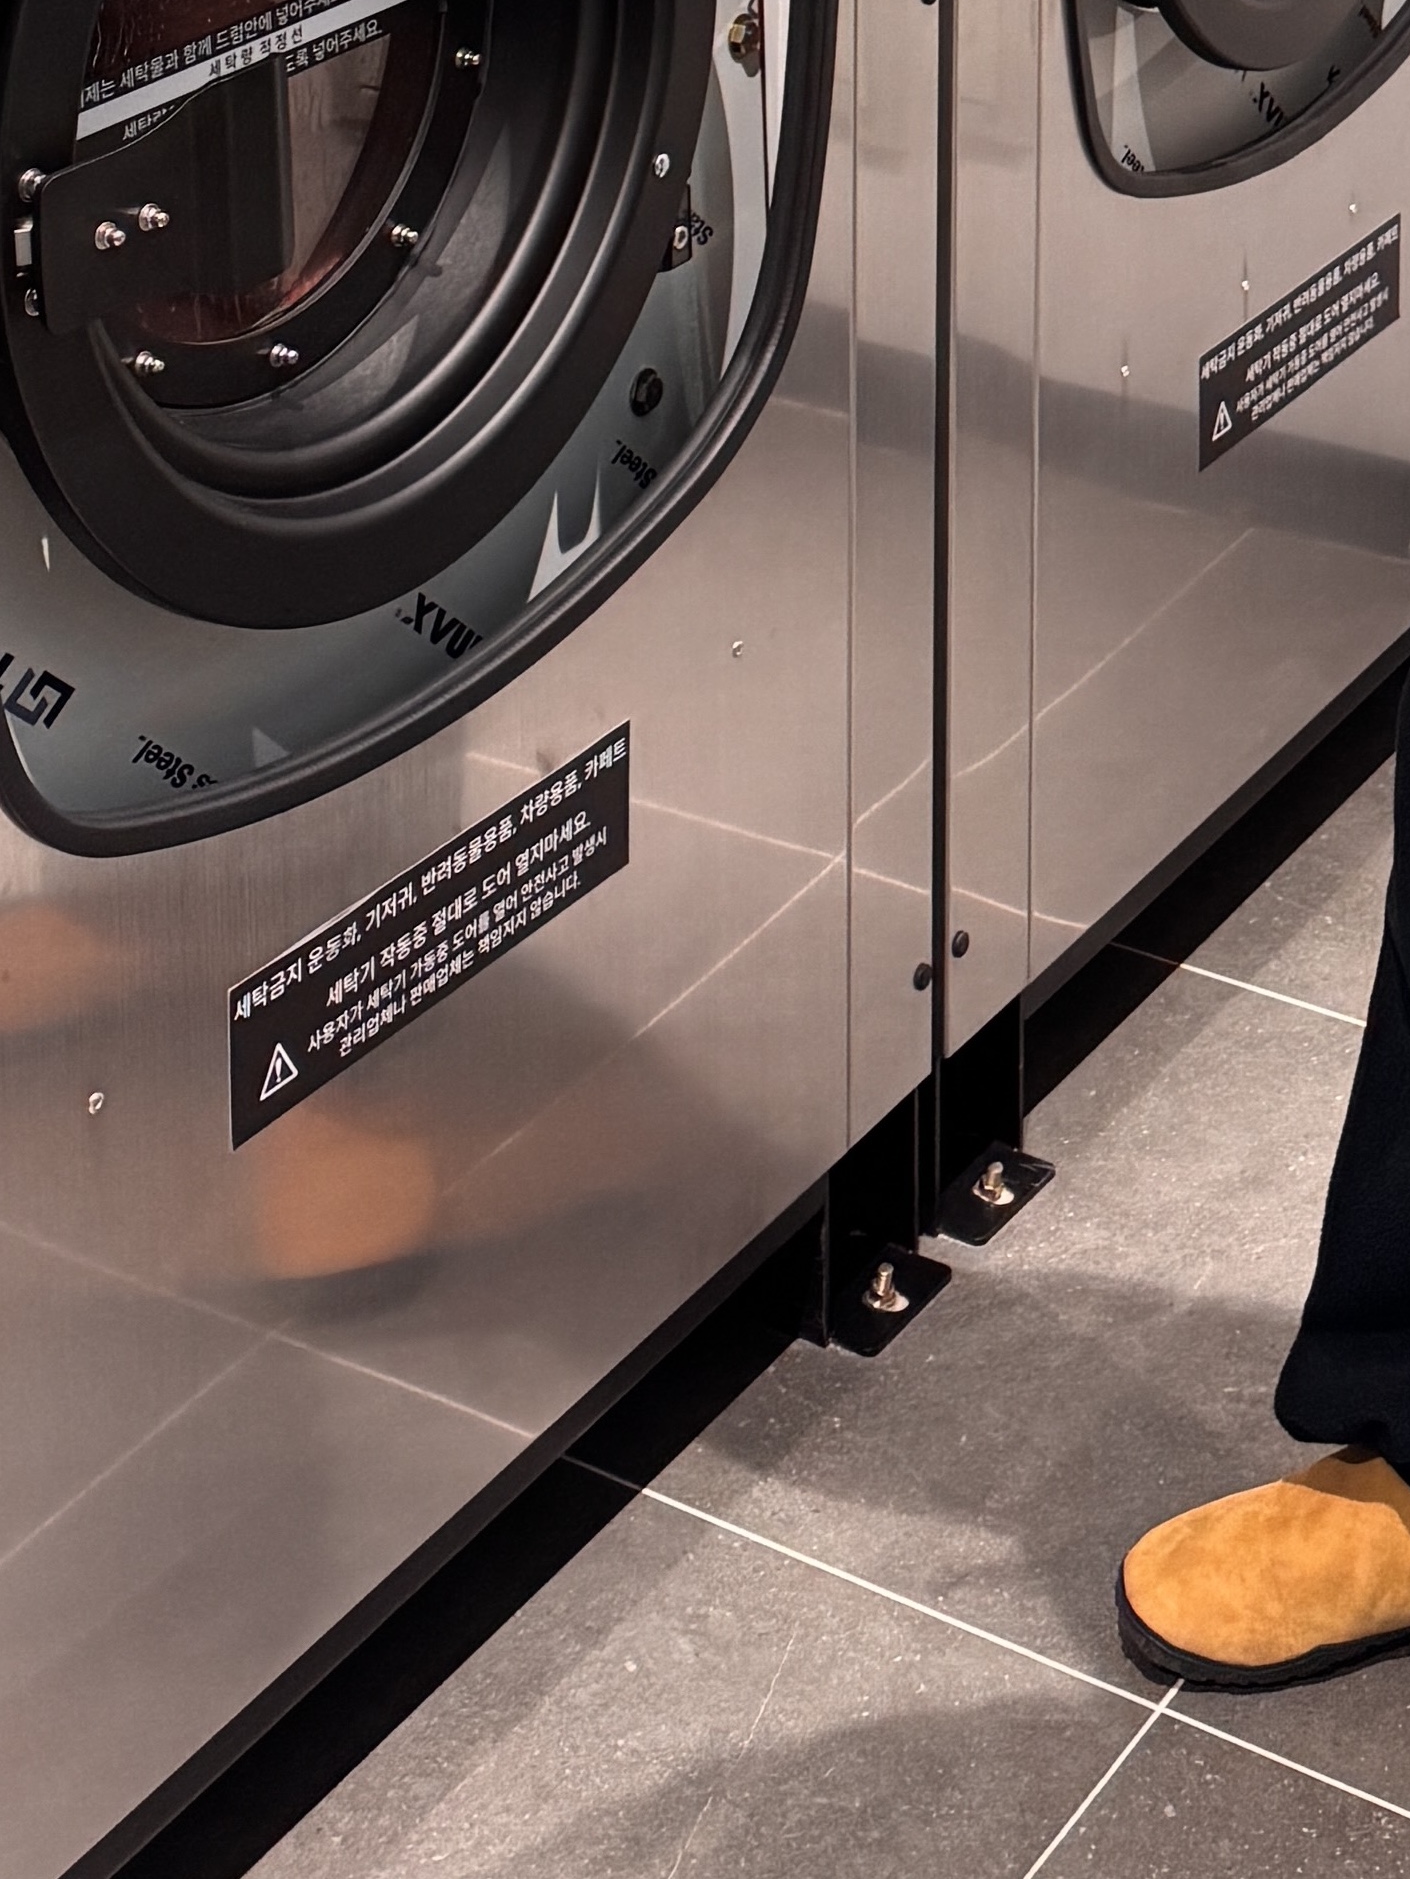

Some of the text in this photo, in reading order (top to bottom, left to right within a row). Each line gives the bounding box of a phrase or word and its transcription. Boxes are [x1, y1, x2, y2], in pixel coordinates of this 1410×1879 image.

[120, 51, 180, 91] 세탁물과
[182, 34, 213, 66] 함께
[215, 14, 274, 50] 드럼안에
[132, 734, 196, 791] Steel.
[233, 737, 627, 1020] 세탁금지 운동화, 기저귀, 반려동물용품, 차량용품, 카페트
[307, 826, 608, 1052] 사용자가 세탁기 가동중 도어를 열어 안전사고 발생시
[326, 960, 376, 1008] 세탁기
[380, 926, 427, 970] 작동중
[430, 894, 478, 934] 절대로
[482, 866, 512, 901] 도어
[338, 999, 407, 1058] 관리업체나
[410, 949, 475, 1008] 판매업체는
[478, 911, 527, 956] 책임지지
